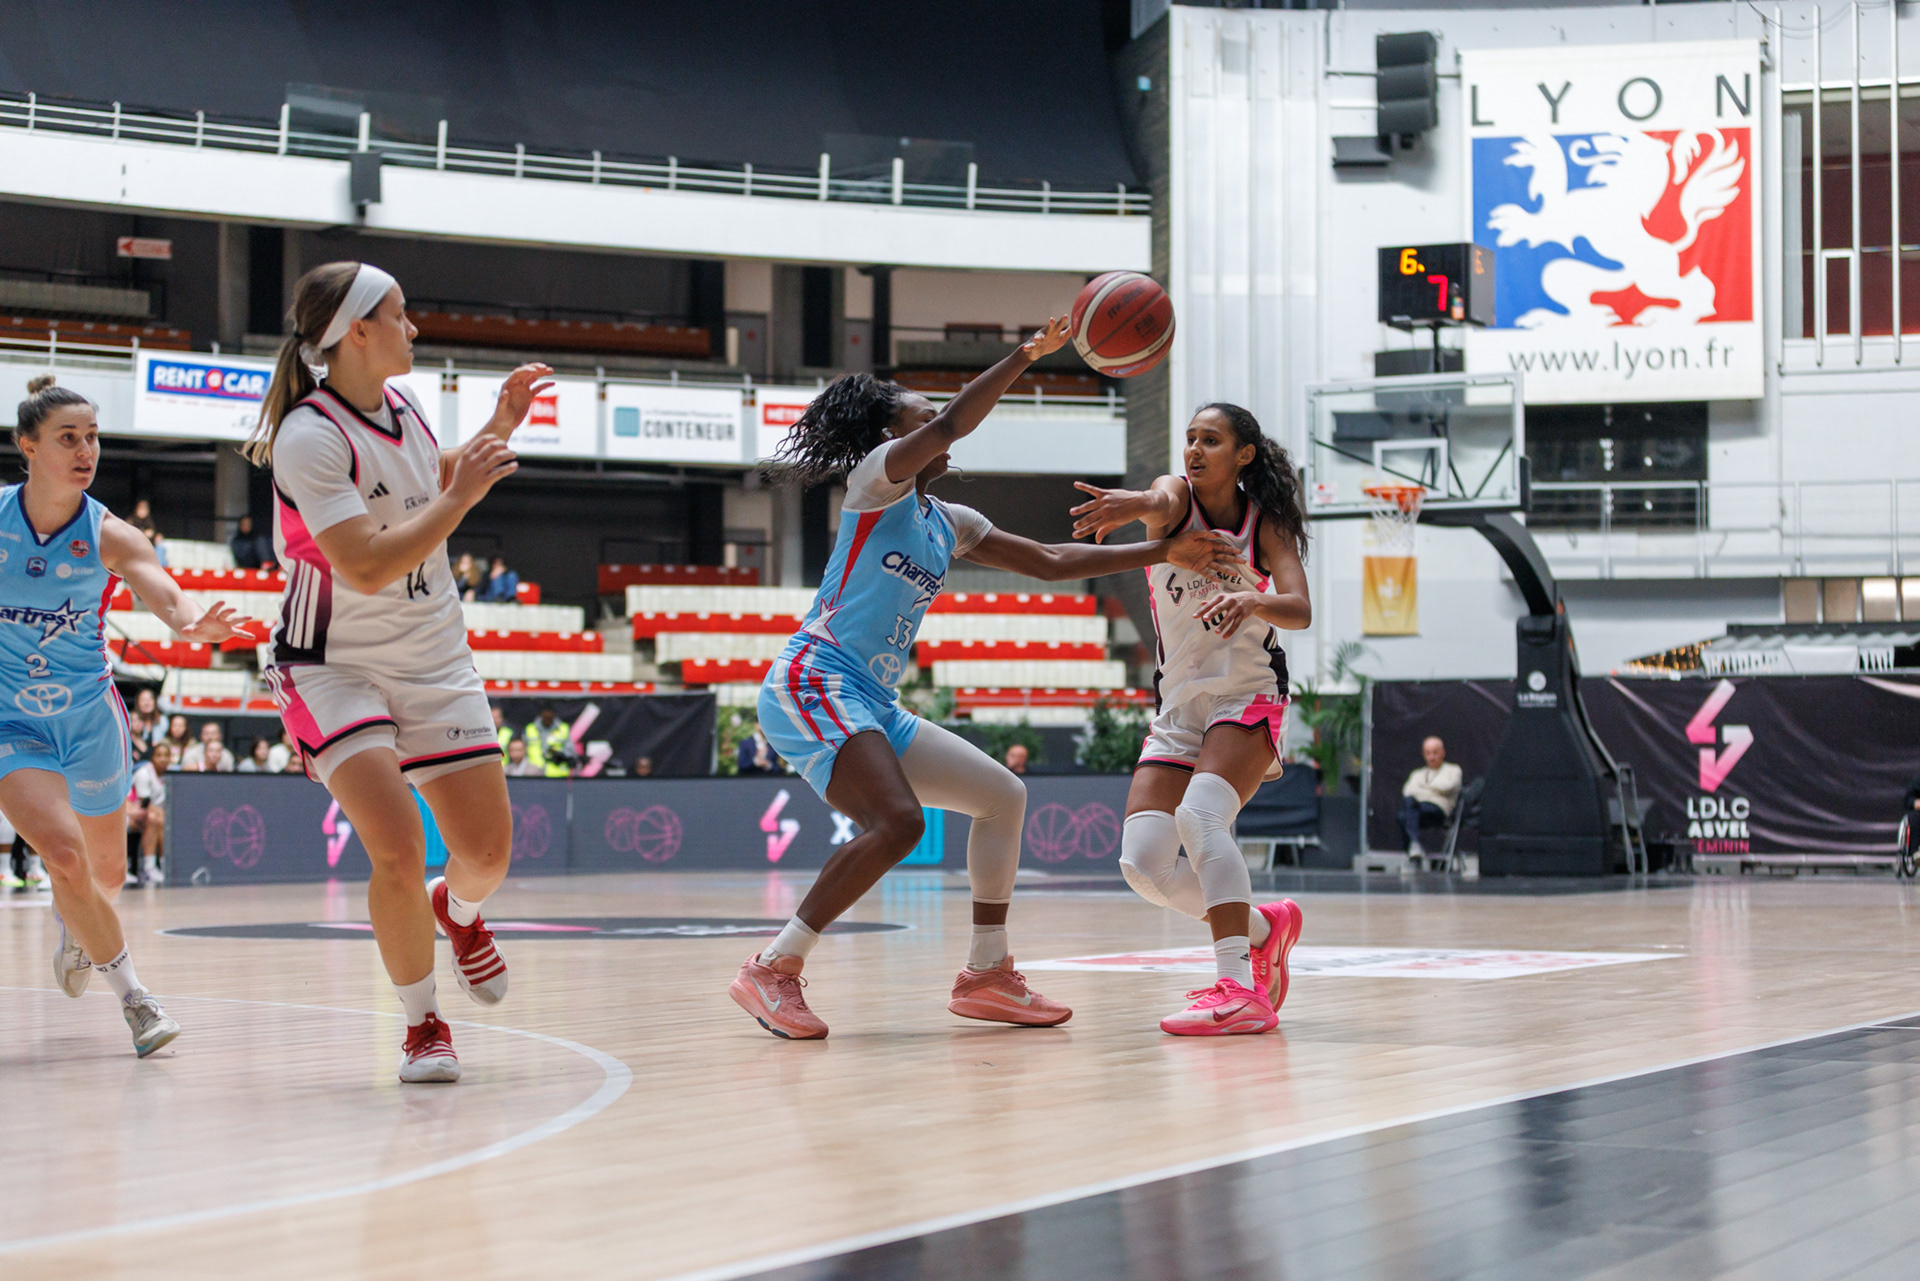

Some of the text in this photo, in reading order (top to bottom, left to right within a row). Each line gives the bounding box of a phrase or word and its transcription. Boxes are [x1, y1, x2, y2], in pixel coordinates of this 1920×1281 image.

[1471, 73, 1752, 127] LYON
[1427, 274, 1448, 312] 7
[1508, 337, 1735, 380] www.lyon.fr
[153, 365, 205, 389] RENT
[223, 372, 265, 394] CAR
[644, 420, 735, 441] CONTENEUR
[406, 561, 431, 600] 14
[881, 551, 943, 597] Chartres
[25, 653, 53, 679] 2
[1686, 797, 1750, 820] LDLC
[1687, 821, 1750, 839] ASVEL
